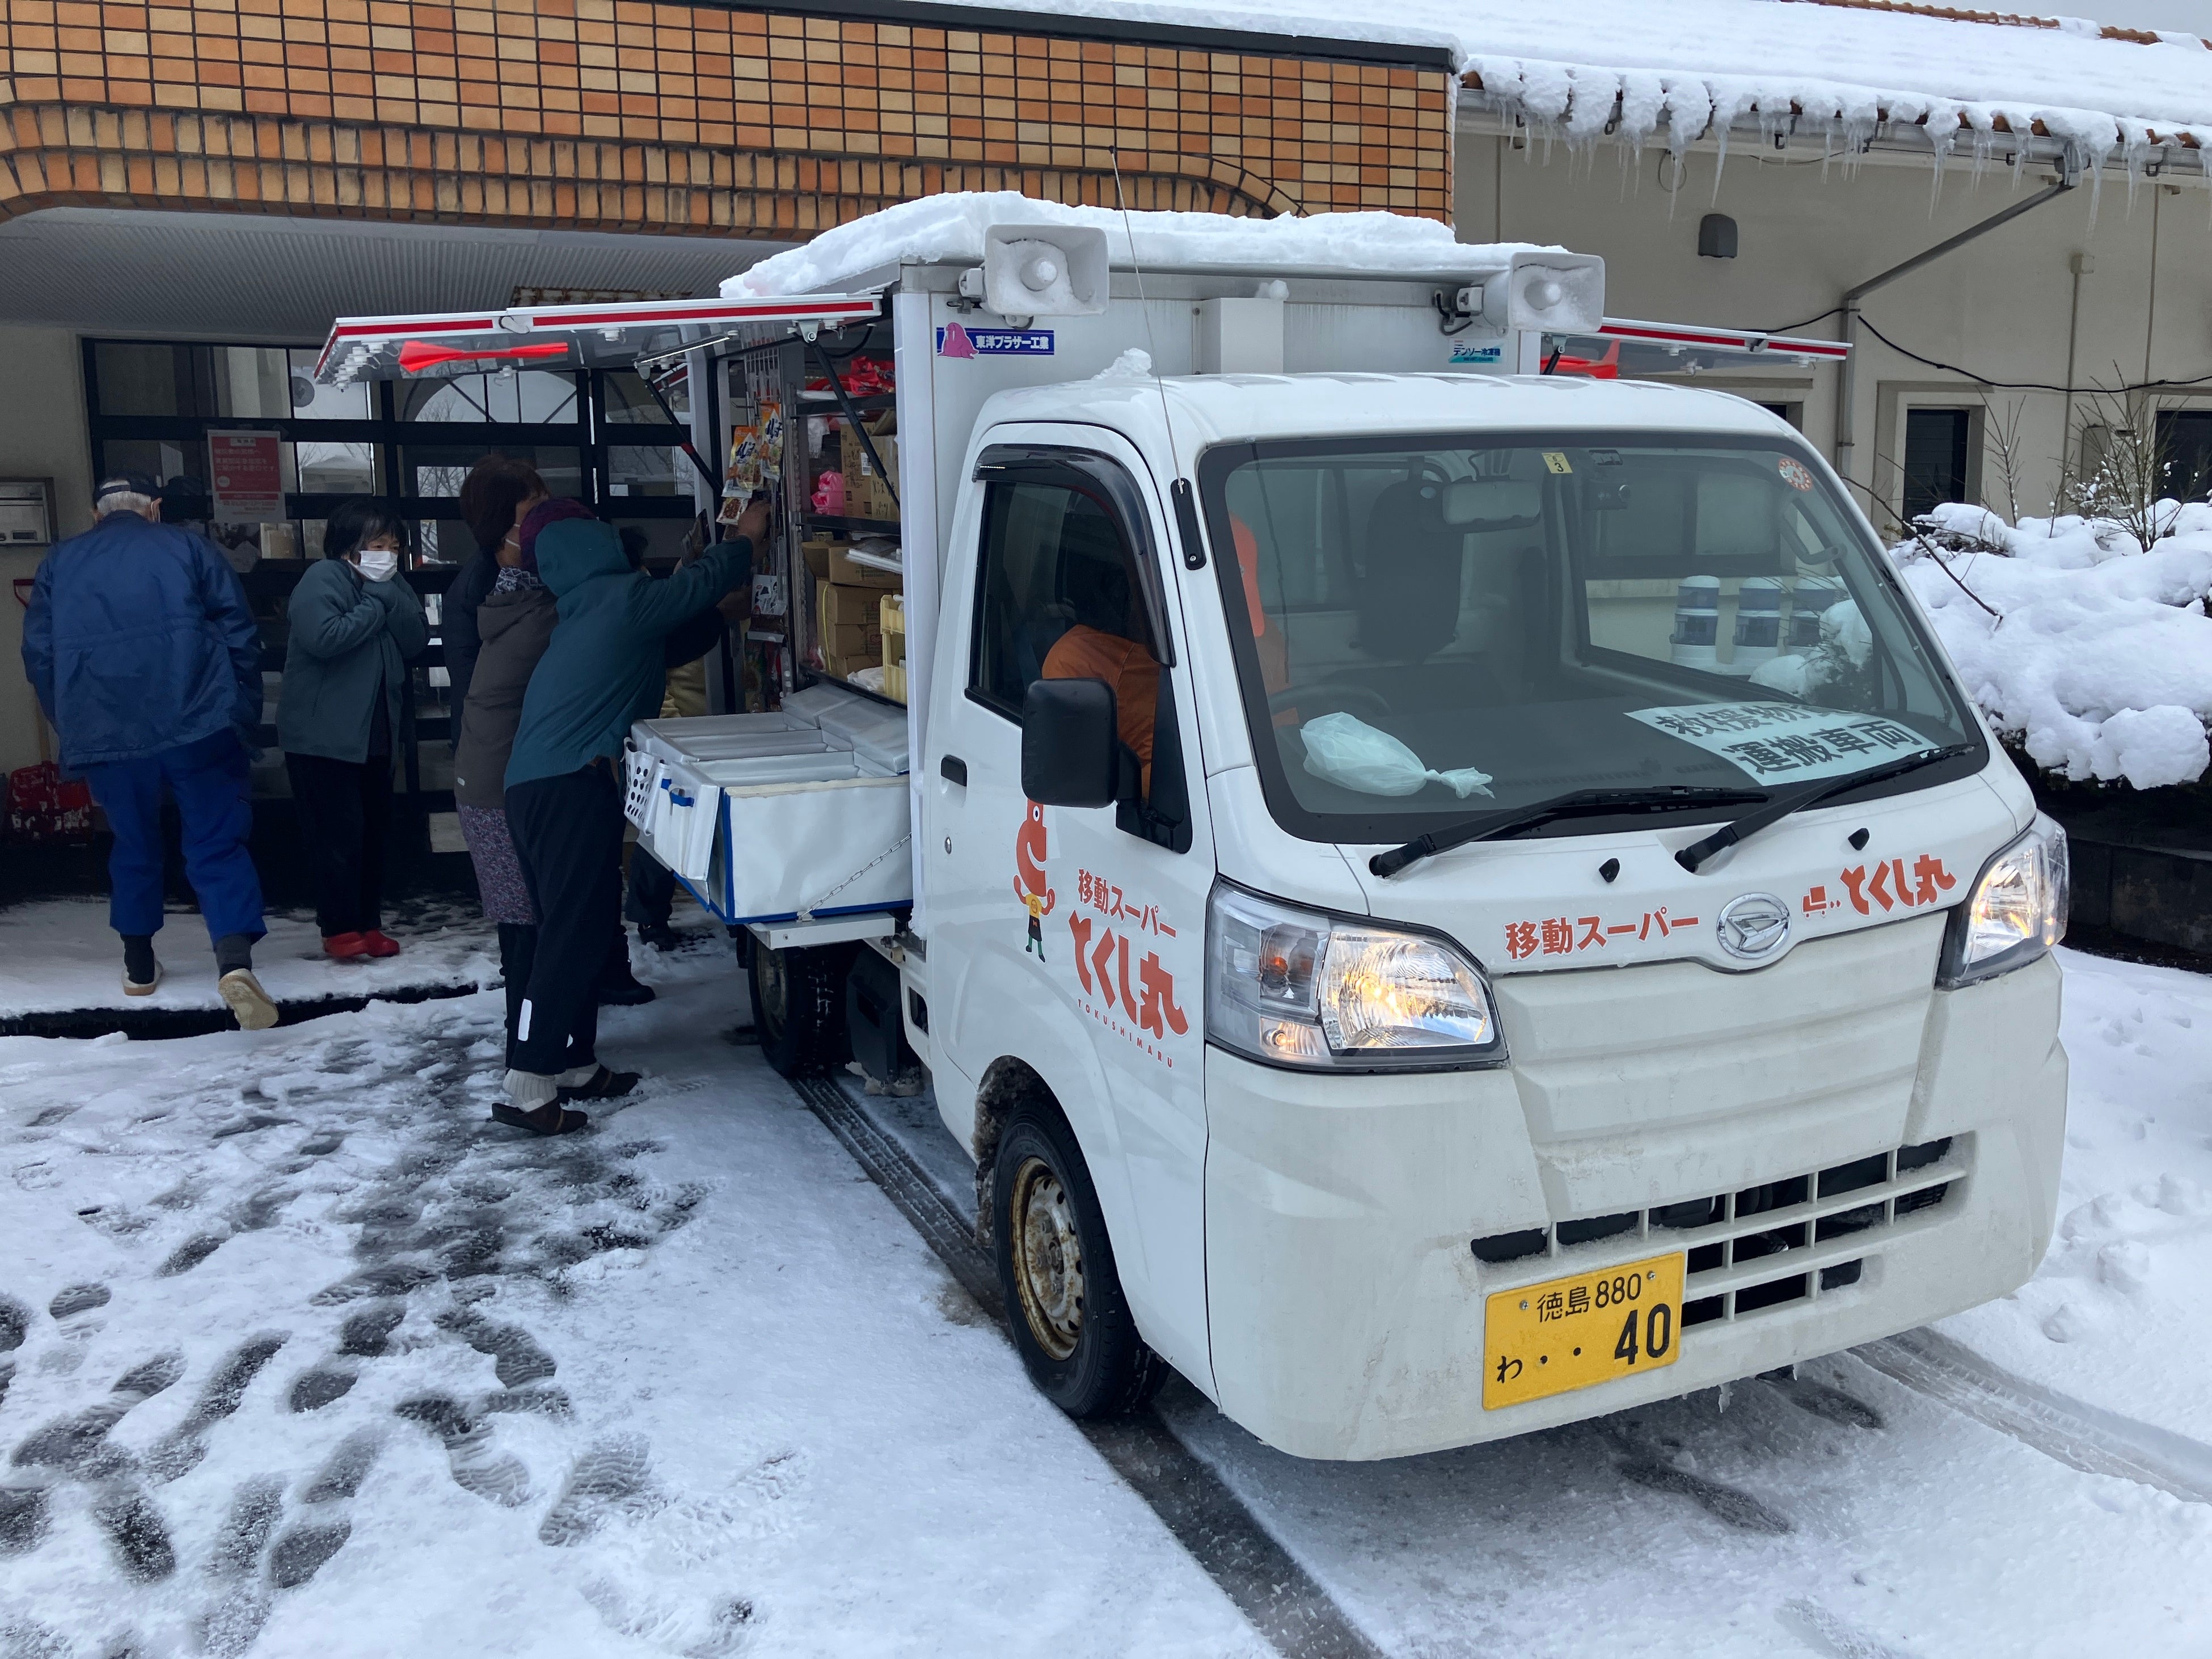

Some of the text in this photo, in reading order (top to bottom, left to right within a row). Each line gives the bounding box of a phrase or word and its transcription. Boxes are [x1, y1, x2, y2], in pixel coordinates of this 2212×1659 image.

[1554, 462, 1564, 472] 3
[1722, 719, 1923, 775] 運搬車両
[1078, 868, 1177, 939] 移動スーパー
[1839, 854, 1957, 915] とくし丸
[1506, 907, 1700, 960] 移動スーパー
[1069, 910, 1190, 1040] とくし丸
[1078, 999, 1173, 1068] TOKUSHIMARU
[1496, 1355, 1523, 1384] わ
